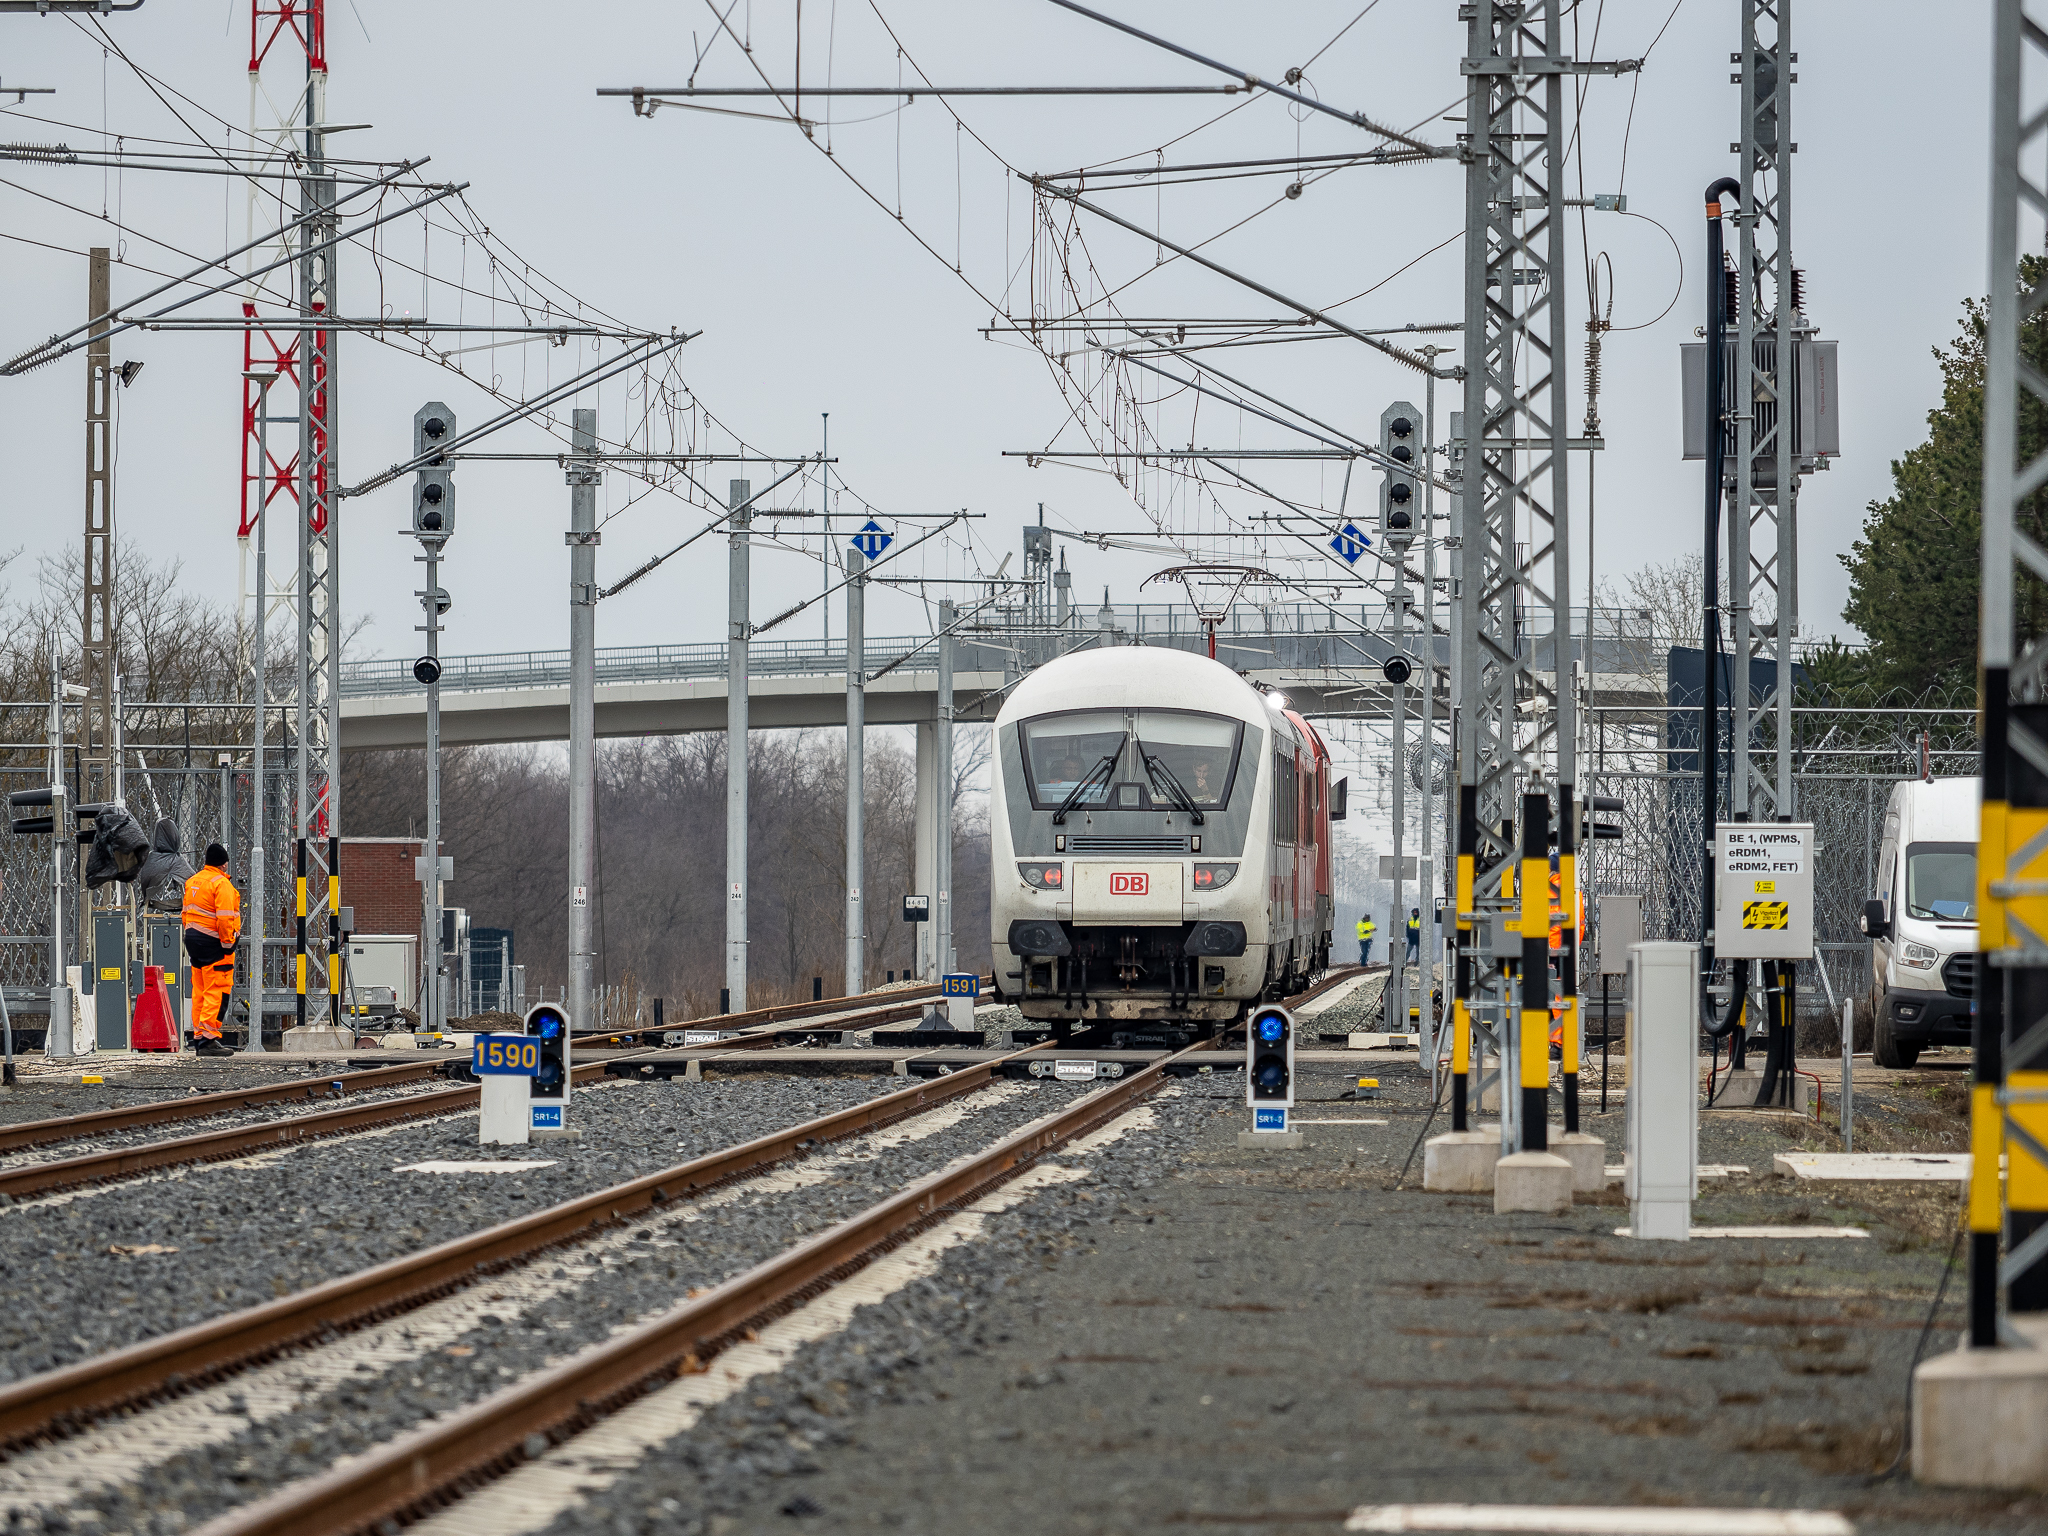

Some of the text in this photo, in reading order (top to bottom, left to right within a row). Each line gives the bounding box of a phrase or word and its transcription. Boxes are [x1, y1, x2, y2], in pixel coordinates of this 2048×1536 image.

[1729, 834, 1801, 846] BE 1, (WPMS,
[1728, 848, 1771, 859] eRDM1,
[1728, 862, 1798, 873] eRDM2, FET)
[1113, 875, 1146, 892] DB
[573, 898, 586, 906] 246
[943, 978, 977, 993] 1591
[1135, 1034, 1166, 1042] STRAIL
[476, 1042, 537, 1069] 1590
[534, 1113, 560, 1121] SR1-4
[1258, 1114, 1283, 1124] SR1-2
